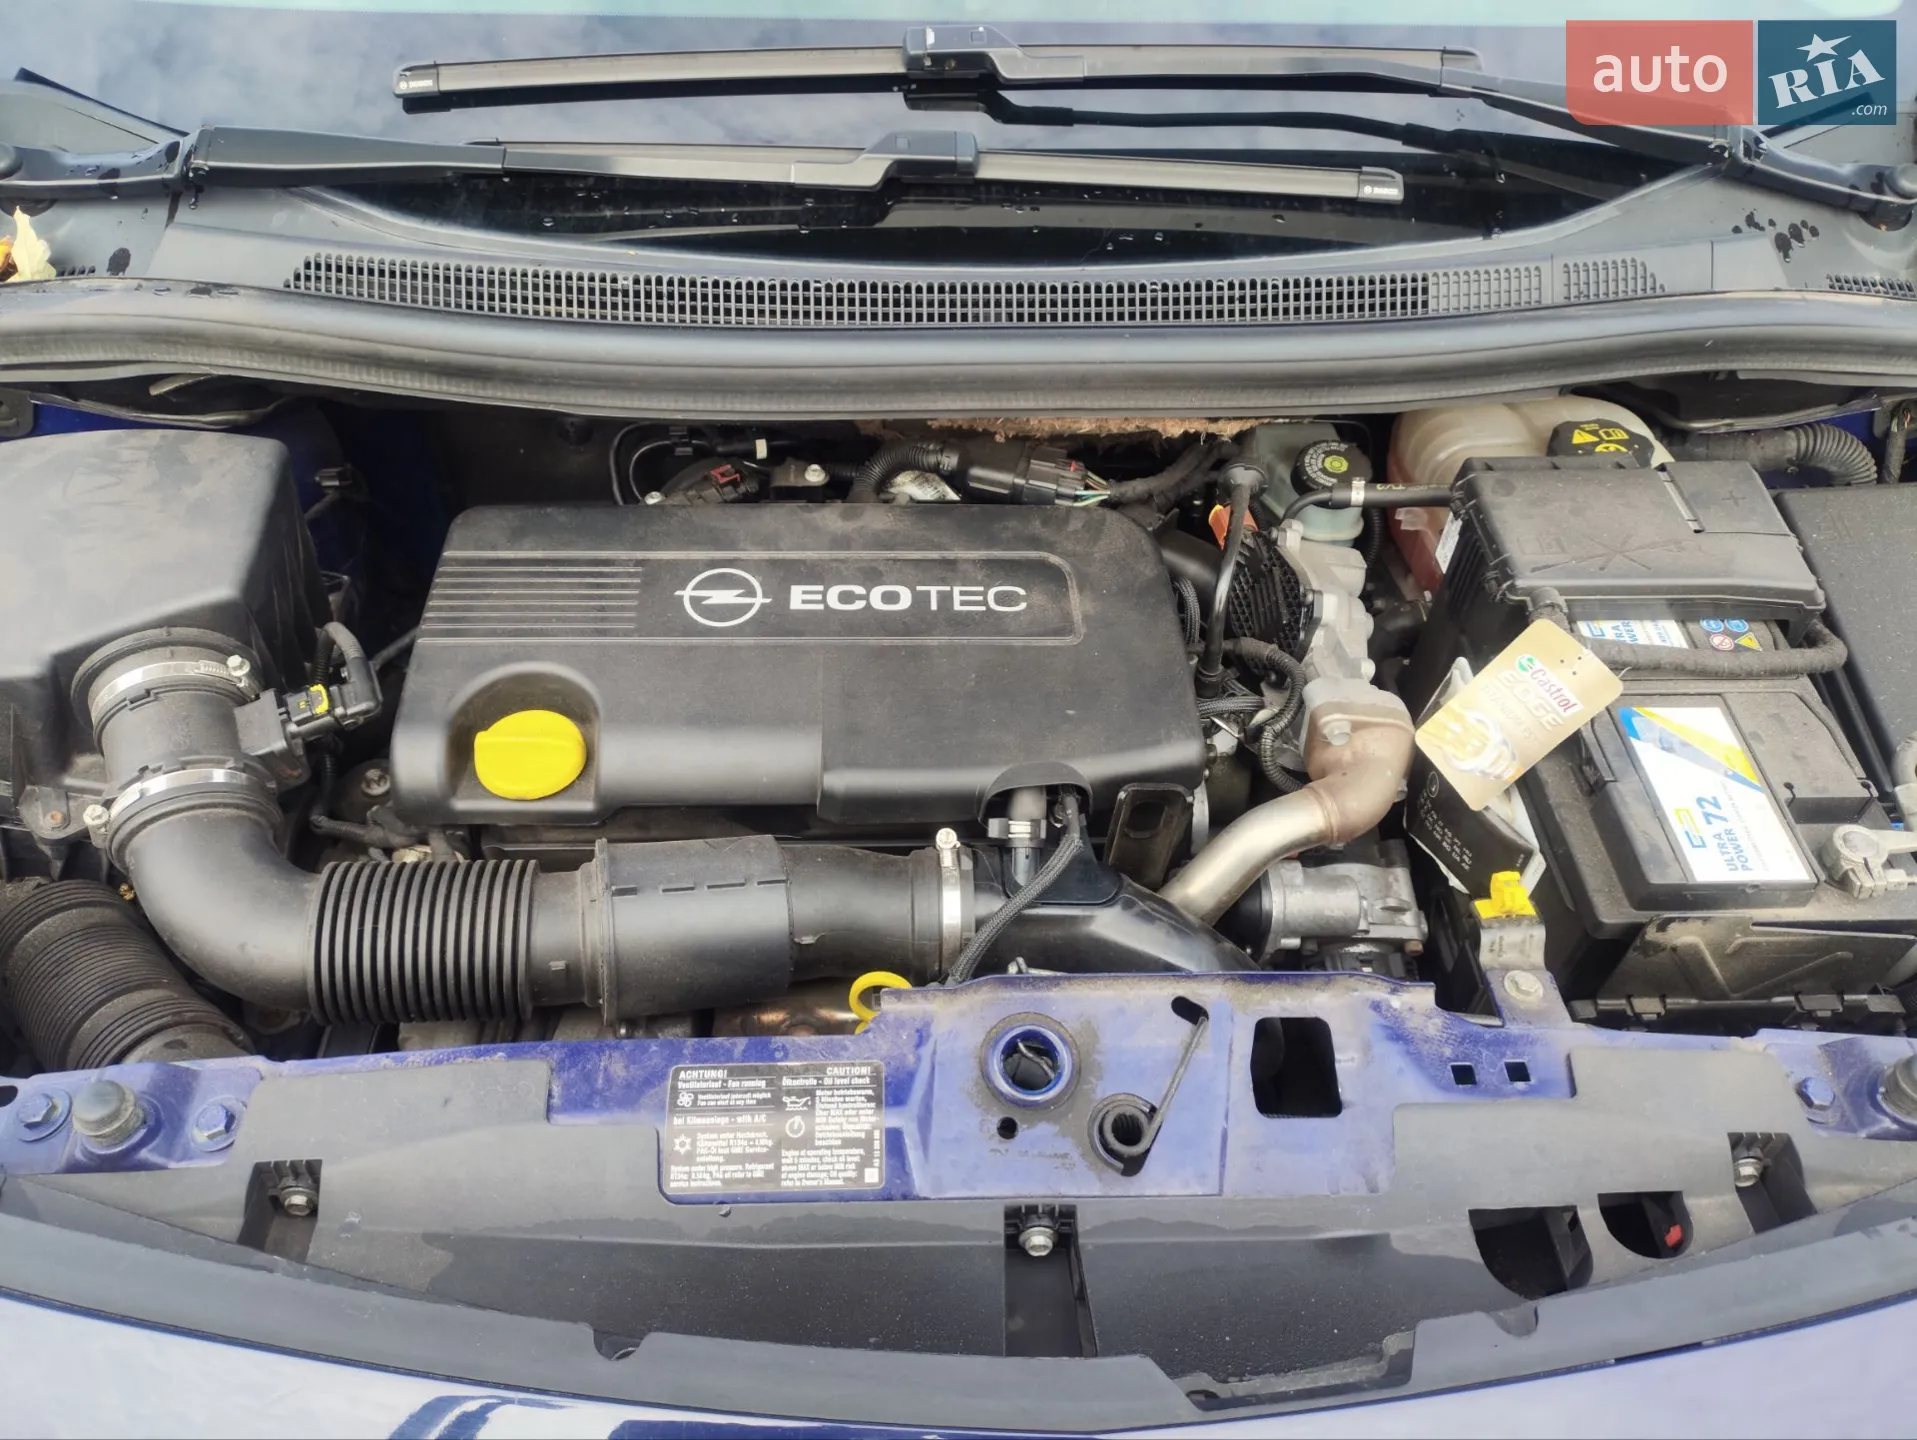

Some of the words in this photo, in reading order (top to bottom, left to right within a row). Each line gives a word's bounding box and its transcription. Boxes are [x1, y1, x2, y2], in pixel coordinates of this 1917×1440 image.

[789, 584, 1027, 612] ECOTEC
[1531, 669, 1578, 713] Castrol
[1696, 795, 1730, 825] 72
[1713, 832, 1739, 872] ULTRA
[1724, 828, 1753, 872] POWER
[679, 1070, 727, 1079] ACHTUNG!
[826, 1066, 871, 1075] CAUTION!
